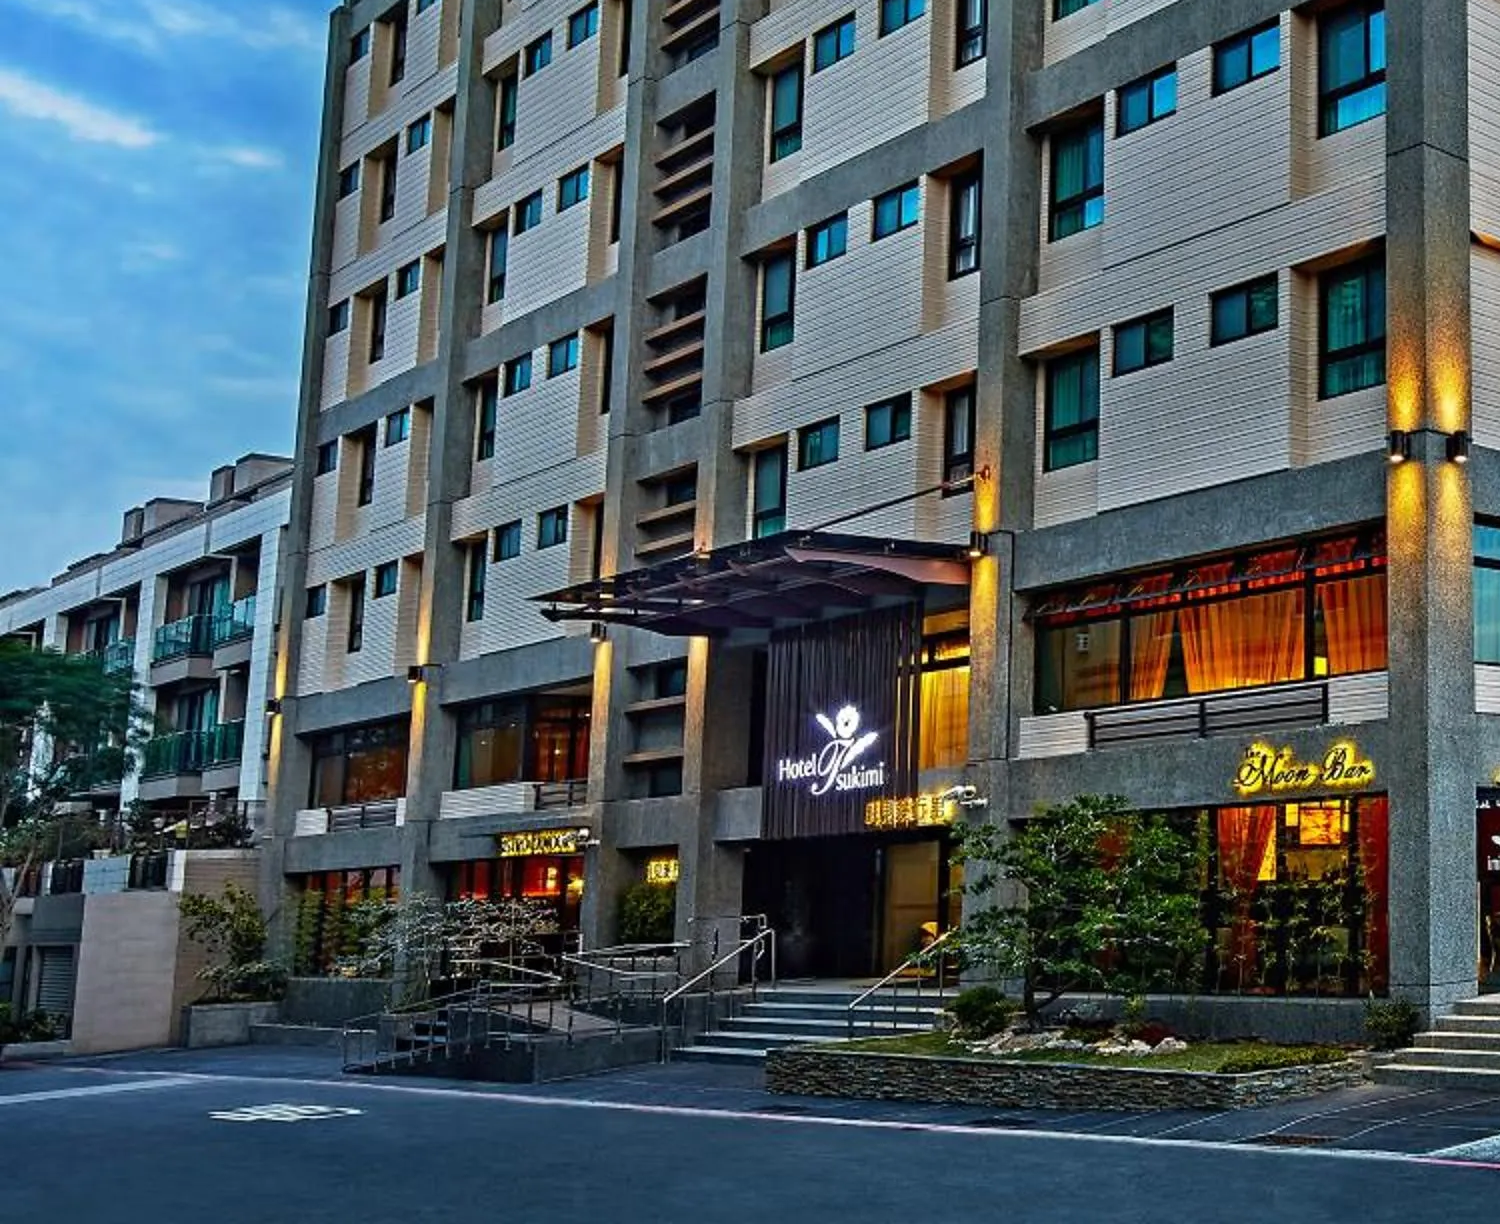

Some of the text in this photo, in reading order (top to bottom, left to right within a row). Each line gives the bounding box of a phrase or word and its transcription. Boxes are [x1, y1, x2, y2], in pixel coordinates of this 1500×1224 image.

[779, 738, 885, 795] Hotel Tsukimi
[1237, 746, 1371, 787] Moon Bar
